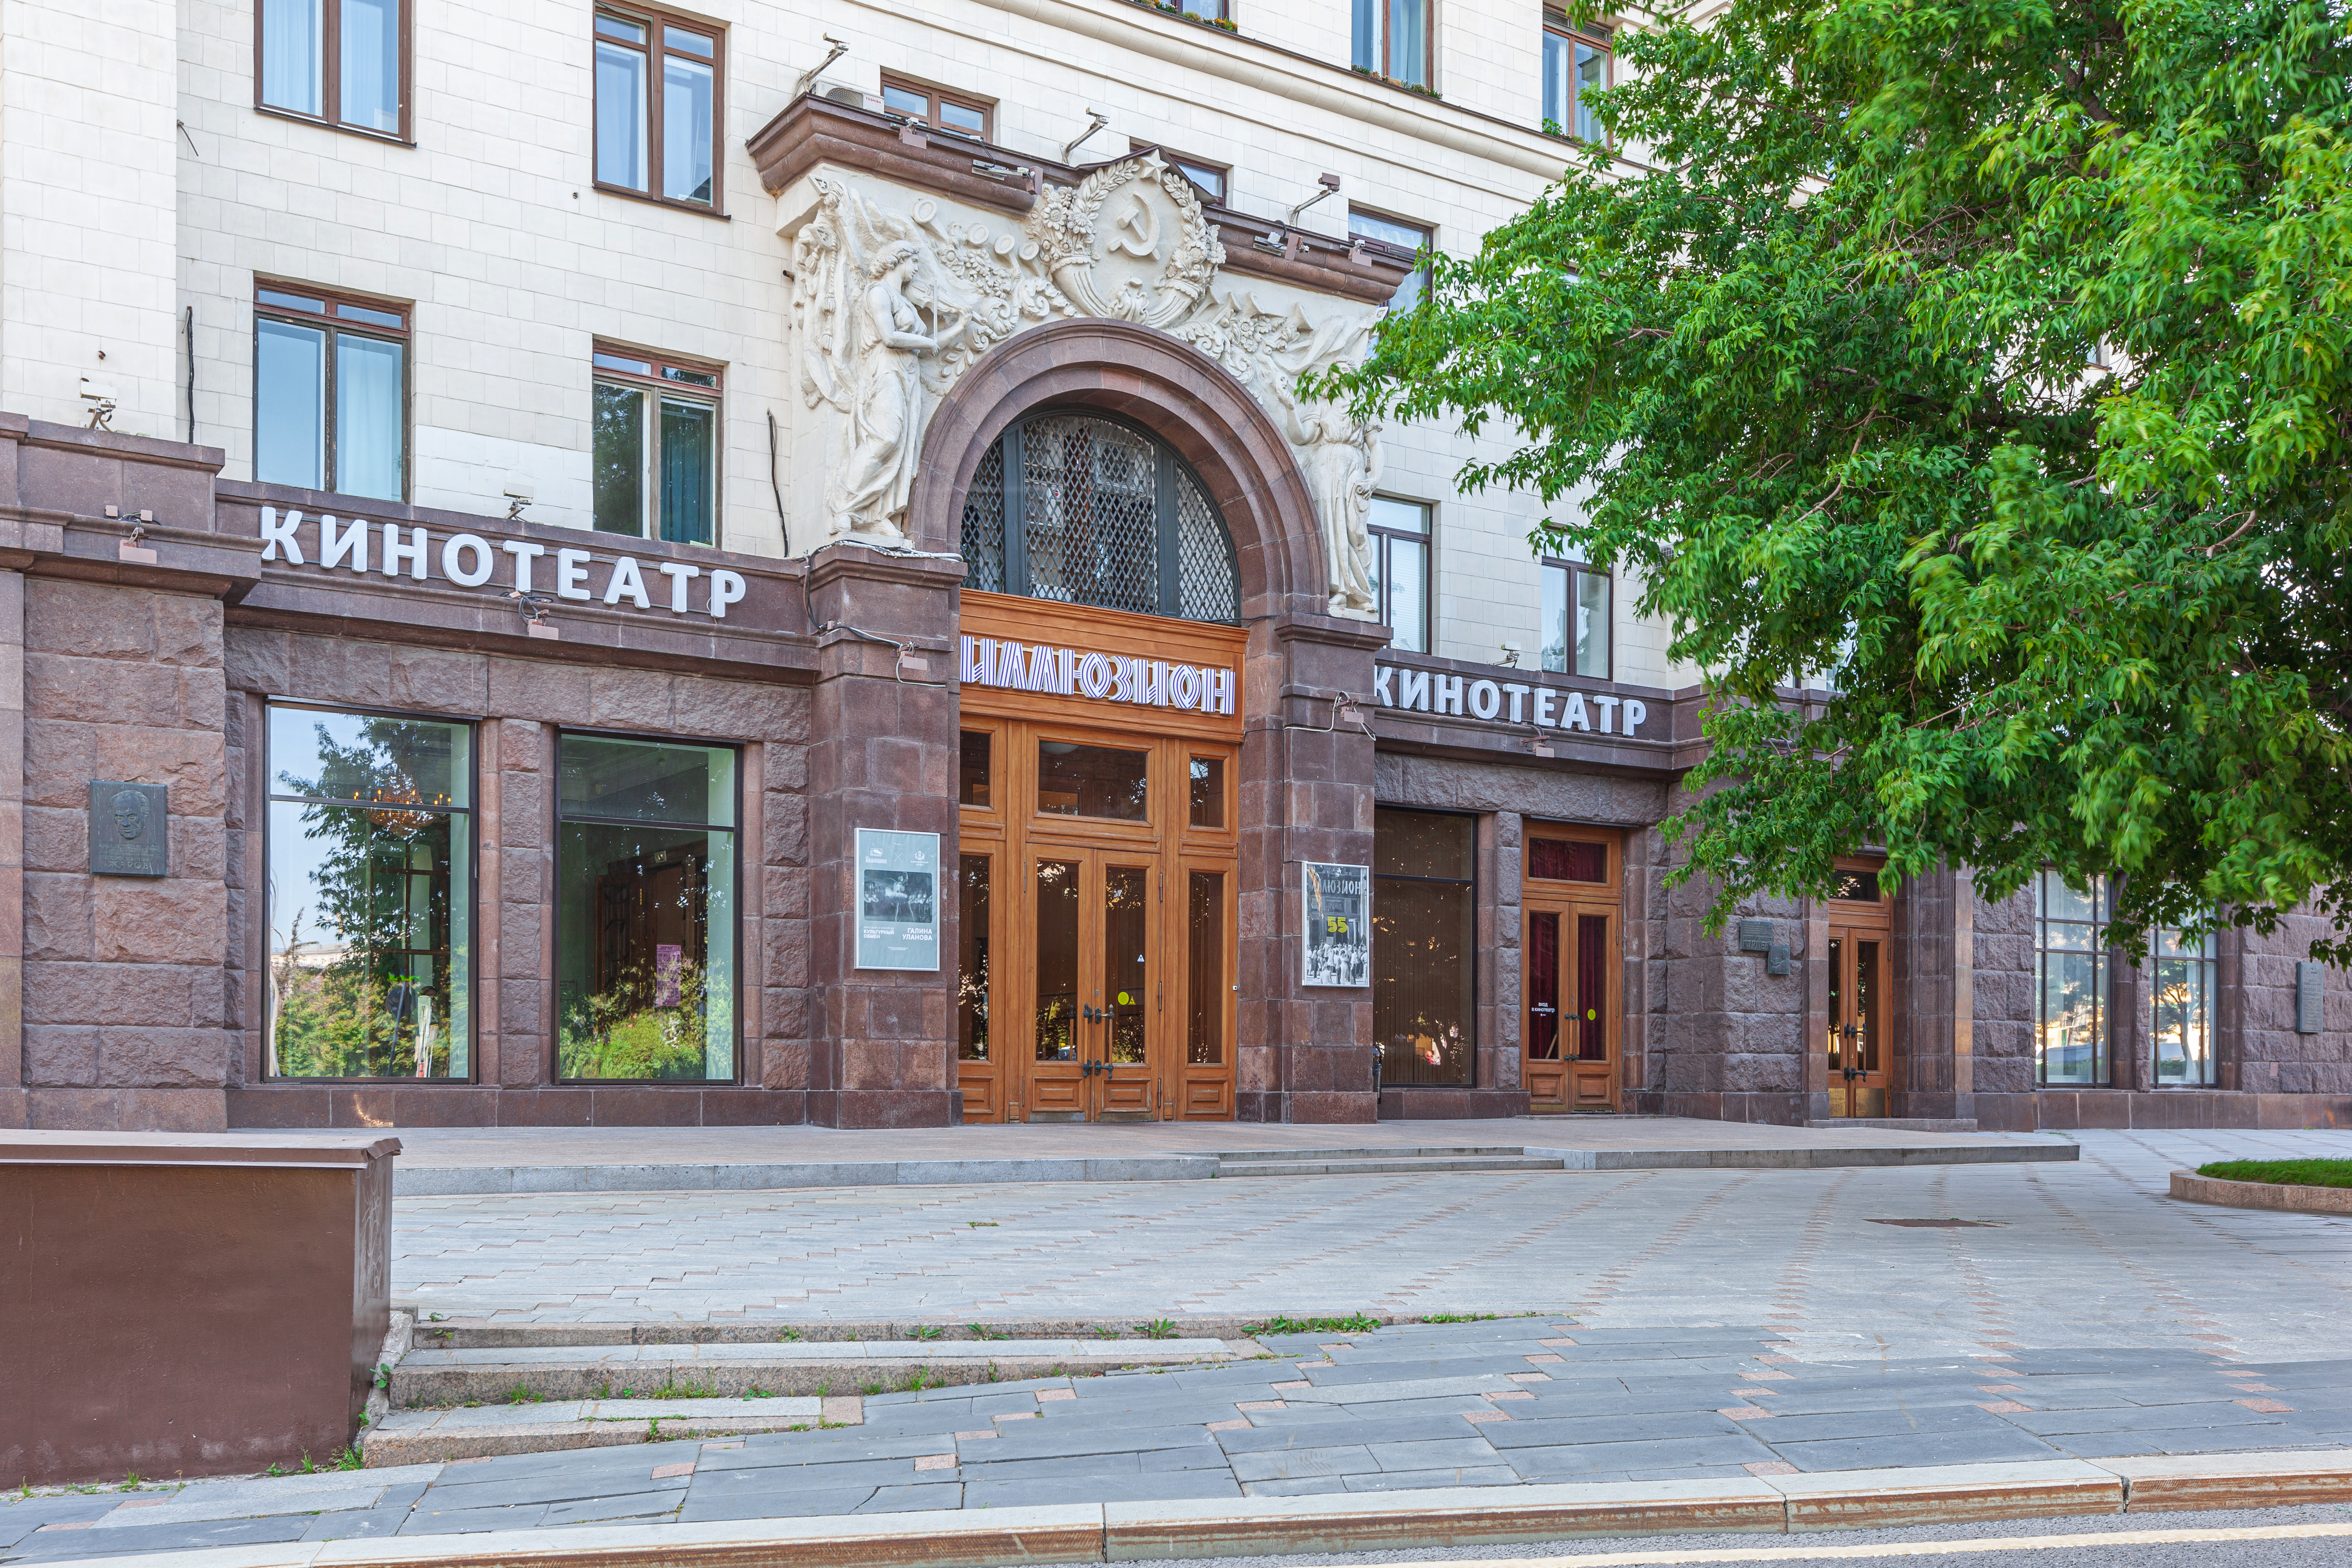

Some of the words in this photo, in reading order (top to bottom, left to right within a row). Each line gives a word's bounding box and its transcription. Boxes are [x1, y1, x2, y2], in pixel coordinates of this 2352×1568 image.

[260, 505, 747, 619] КИНОТЕАТР
[960, 635, 1235, 715] ИЛЛЮЗИОН
[1374, 665, 1647, 736] КИНОТЕАТР
[108, 861, 149, 870] ЖАРОВ
[1327, 916, 1347, 933] 55
